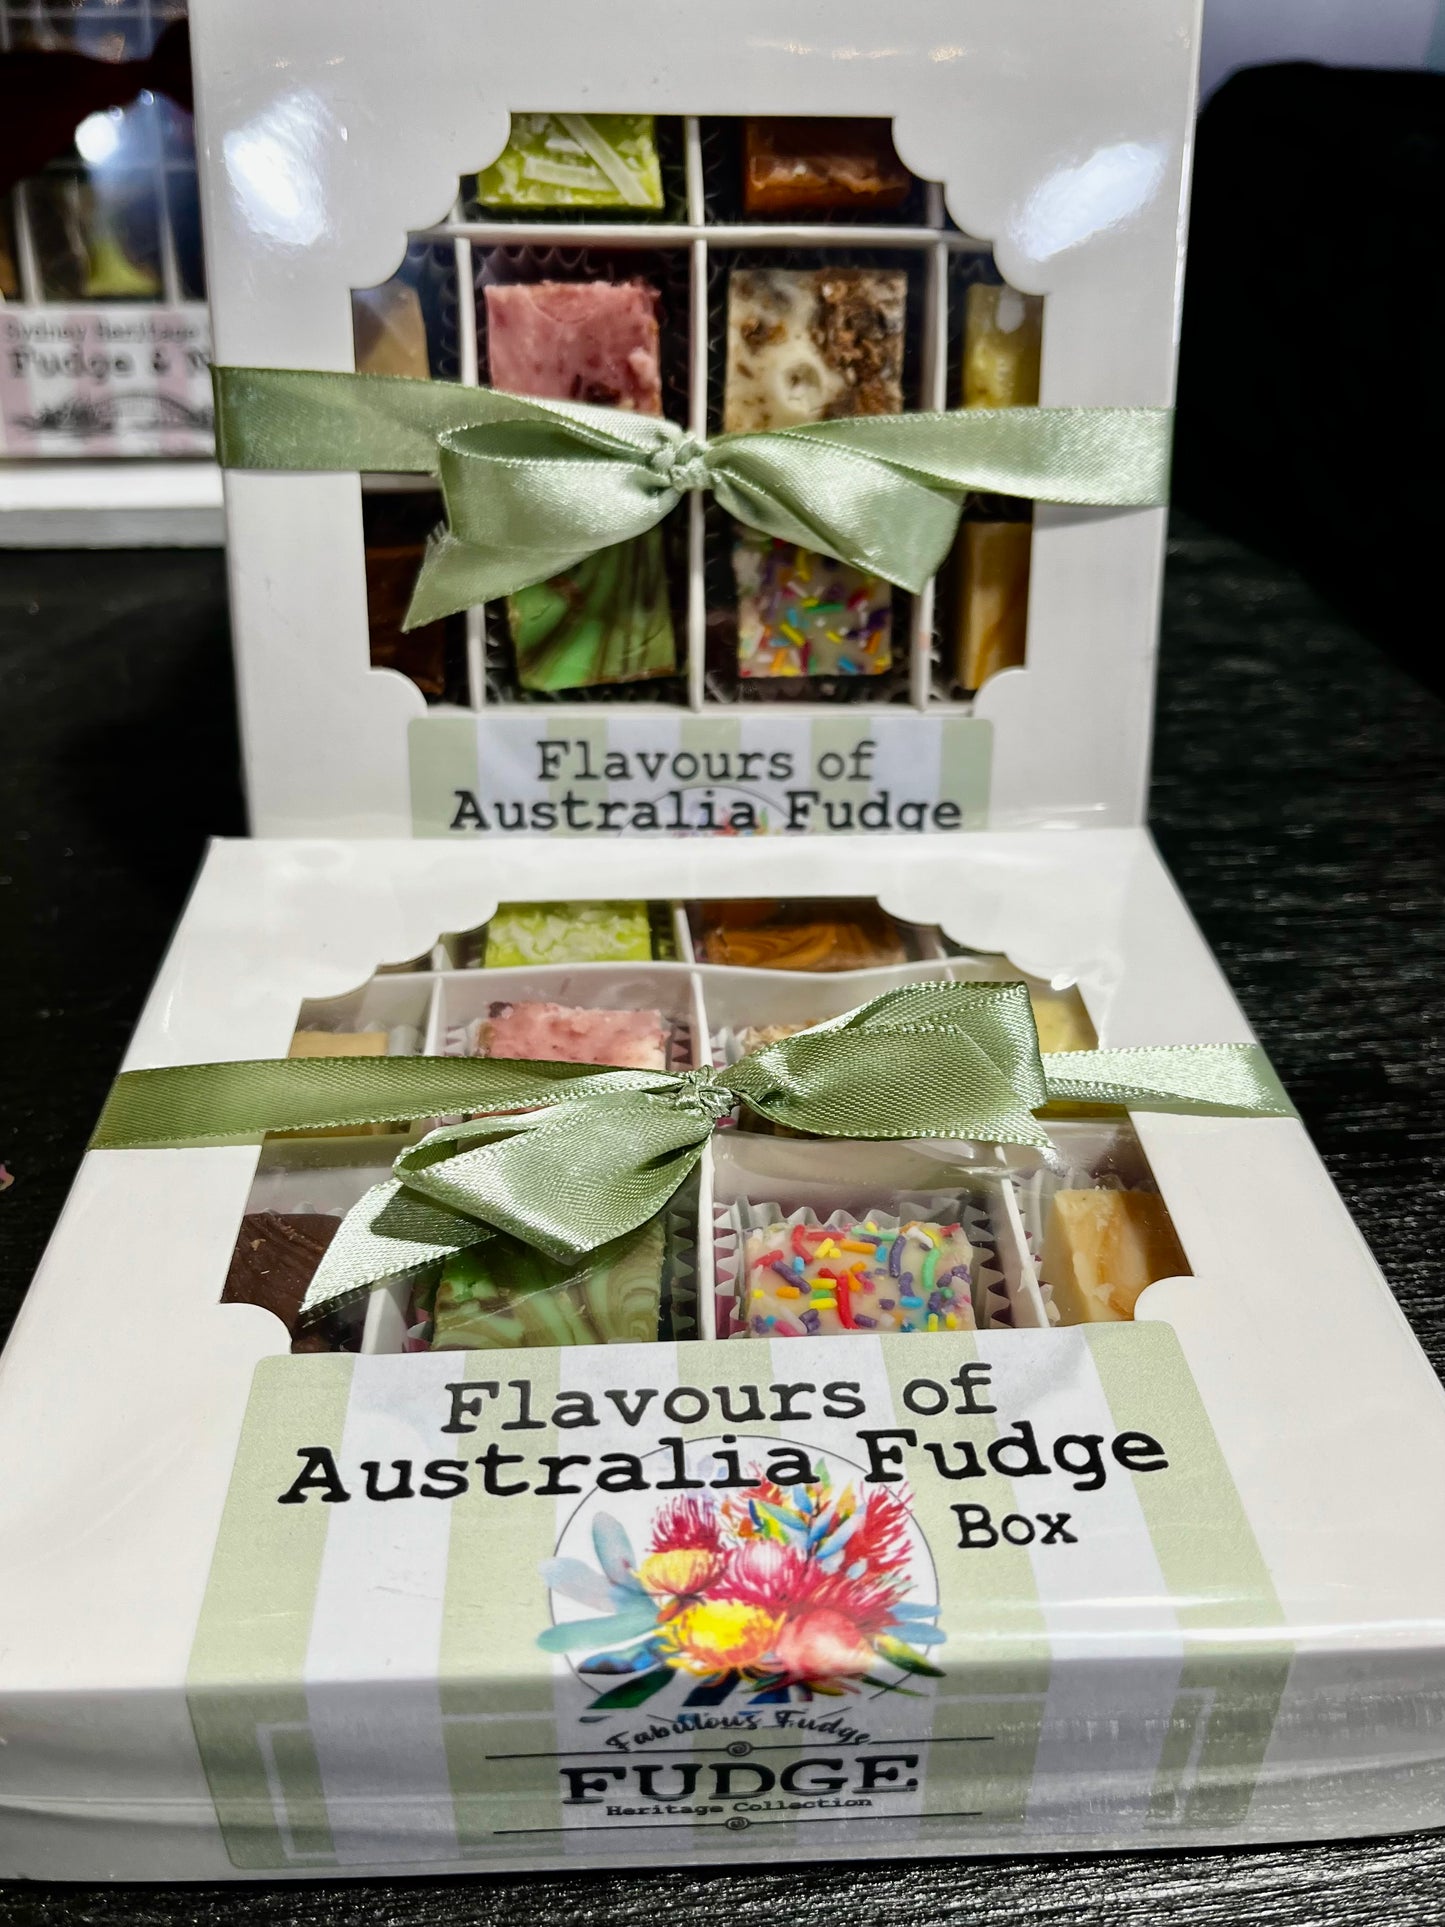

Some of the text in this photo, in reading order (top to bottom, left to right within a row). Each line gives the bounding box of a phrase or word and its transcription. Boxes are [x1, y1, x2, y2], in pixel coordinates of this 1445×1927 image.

[12, 345, 132, 384] Fudge
[537, 741, 877, 781] Flavours of
[450, 790, 759, 831] Australia
[441, 1363, 998, 1434] Flavours of
[277, 1421, 1170, 1505] Australia Fudge
[951, 1503, 1079, 1550] Box
[606, 1709, 873, 1752] Fabulous Fudge
[560, 1754, 920, 1804] FUDGE
[606, 1796, 873, 1816] Heritage Collection
